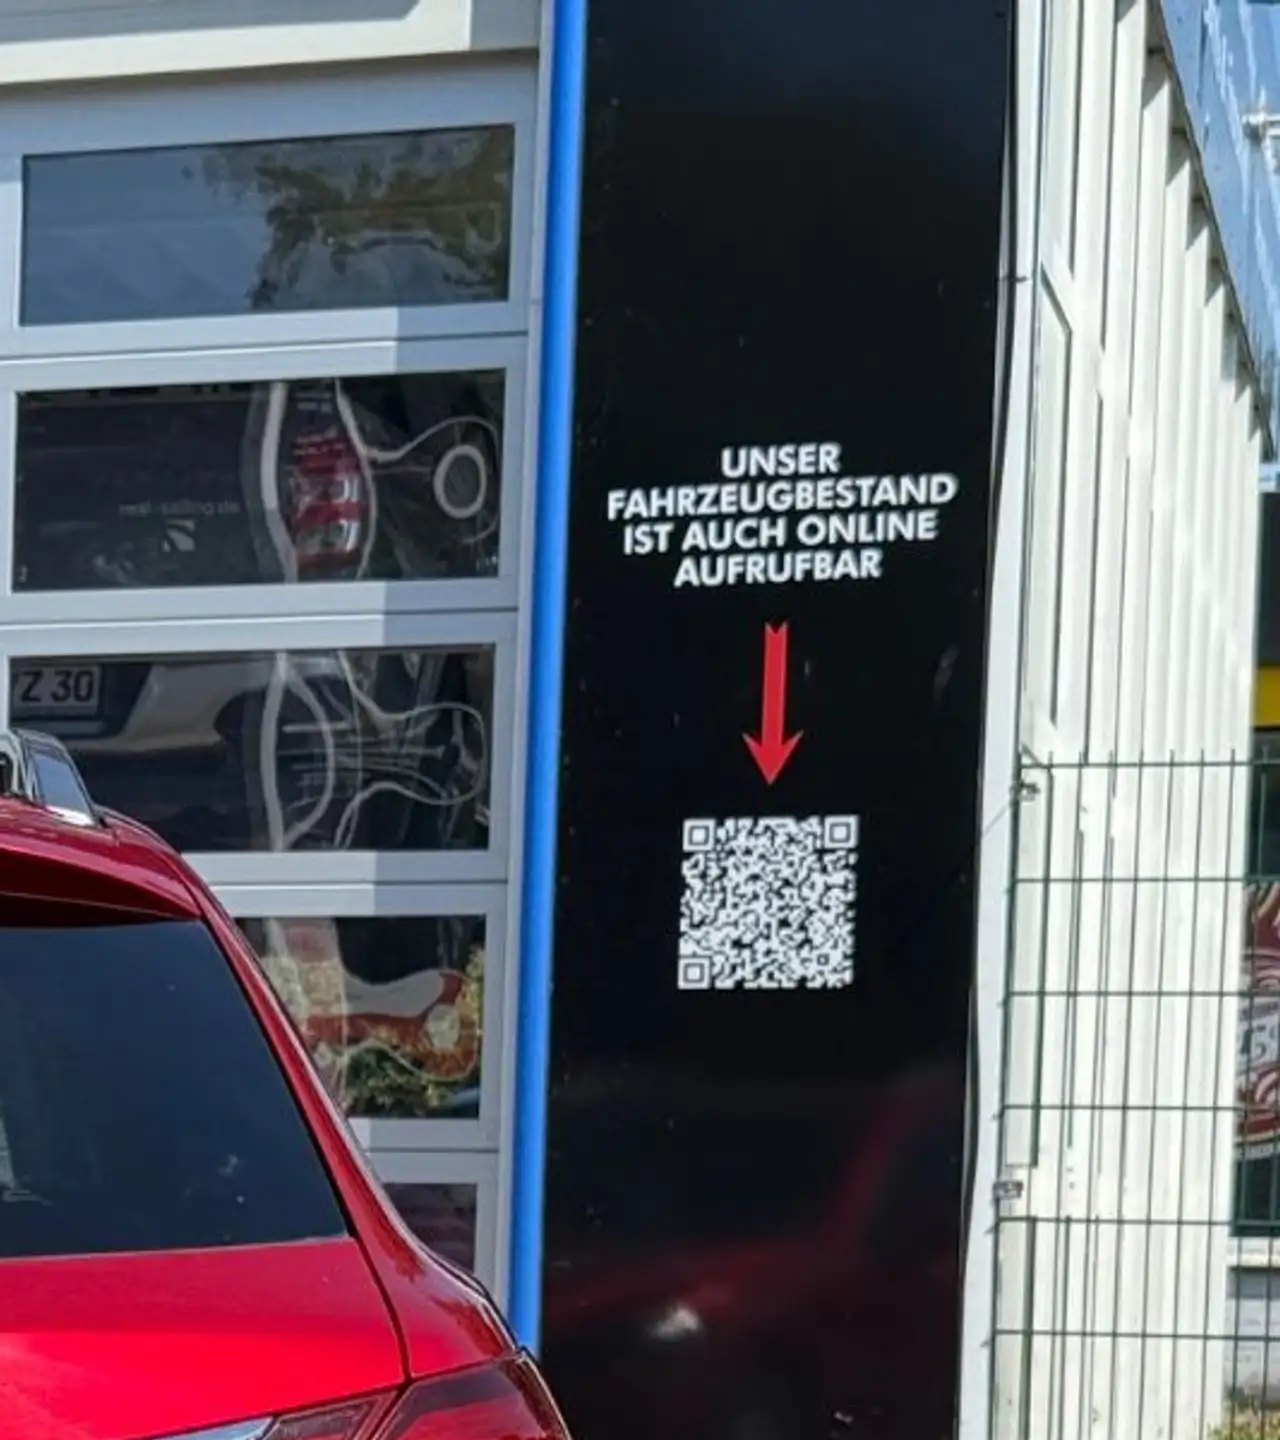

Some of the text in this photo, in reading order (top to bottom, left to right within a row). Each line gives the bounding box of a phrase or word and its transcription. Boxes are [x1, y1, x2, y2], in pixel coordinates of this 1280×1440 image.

[720, 442, 841, 479] UNSER
[606, 473, 959, 522] FAHRZEUGBESTAND
[623, 510, 940, 556] IST AUCH ONLINE
[673, 548, 884, 589] AUFRUFBAR
[51, 669, 94, 703] 30
